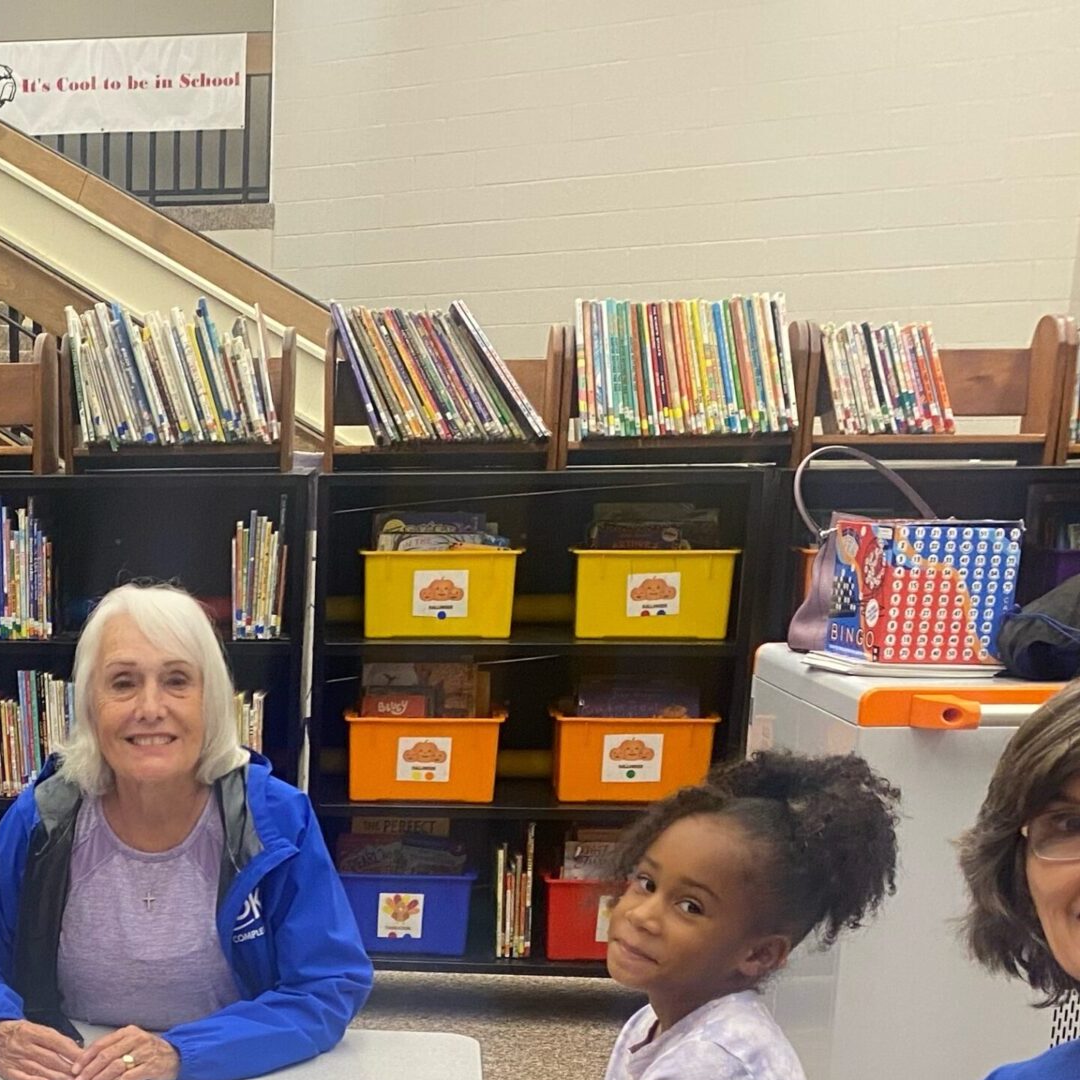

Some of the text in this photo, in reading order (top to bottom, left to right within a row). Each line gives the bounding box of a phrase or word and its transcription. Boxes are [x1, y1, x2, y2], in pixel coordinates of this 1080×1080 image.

[22, 71, 241, 93] It's Cool to be in School
[831, 623, 874, 648] BINGO
[383, 819, 437, 833] PERFECT
